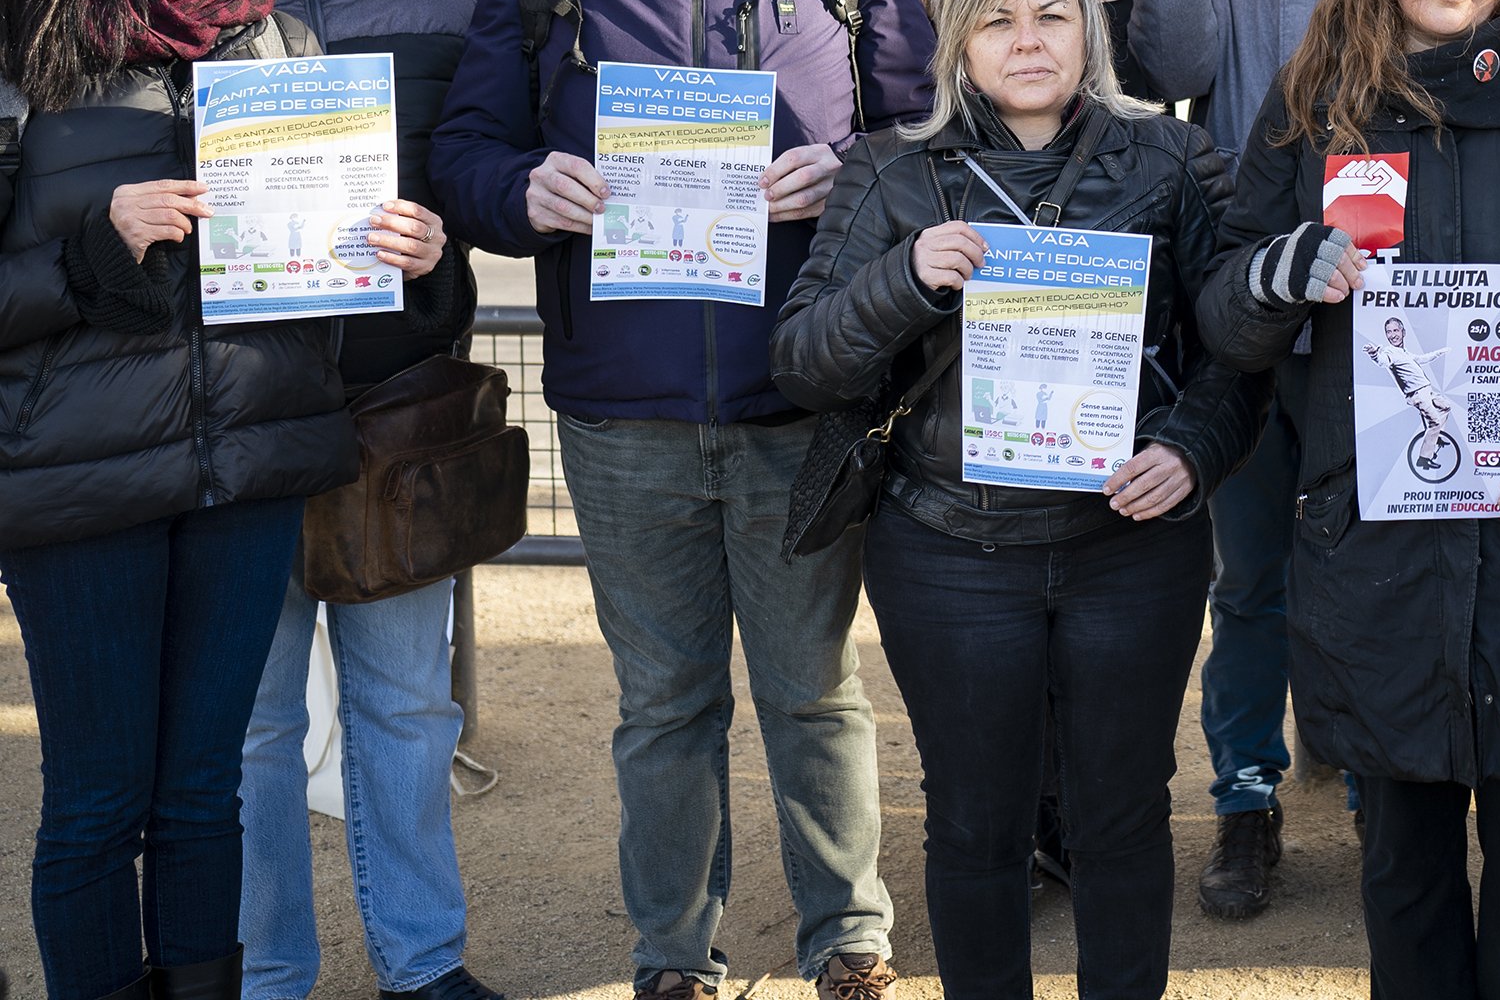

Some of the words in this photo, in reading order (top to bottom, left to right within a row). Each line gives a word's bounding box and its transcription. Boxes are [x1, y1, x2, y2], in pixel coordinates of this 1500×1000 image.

[260, 61, 327, 77] VAGA
[655, 70, 716, 85] VAGA
[208, 83, 280, 108] SANITAT
[284, 83, 287, 92] I
[292, 77, 389, 92] EDUCACIÓ
[601, 86, 674, 99] SANITAT
[677, 90, 680, 99] I
[684, 92, 770, 105] EDUCACIÓ
[216, 105, 239, 119] 25
[242, 103, 247, 113] I
[251, 100, 276, 112] 26
[281, 99, 307, 110] DE
[311, 98, 377, 108] GENER
[612, 103, 635, 113] 25
[639, 104, 642, 113] I
[646, 105, 669, 114] 26
[673, 107, 695, 117] DE
[699, 108, 759, 121] GENER
[200, 160, 212, 168] 25
[215, 158, 253, 167] GENER
[287, 156, 323, 165] GENER
[339, 155, 352, 163] 28
[354, 154, 389, 162] GENER
[612, 155, 644, 164] GENER
[674, 159, 706, 169] GENER
[735, 163, 766, 172] GENER
[1026, 231, 1089, 247] VAGA
[984, 250, 1045, 263] ANITAT
[1048, 253, 1051, 263] I
[1055, 254, 1145, 271] EDUCACIÓ
[980, 267, 1003, 277] 25
[1008, 268, 1012, 277] I
[1015, 268, 1039, 279] 26
[1044, 271, 1066, 282] DE
[1071, 273, 1132, 286] GENER
[1391, 270, 1422, 286] EN
[1424, 270, 1489, 286] LLUITA
[1362, 292, 1400, 307] PER
[1404, 292, 1429, 308] LA
[966, 321, 976, 330] 25
[978, 323, 1011, 333] GENER
[1028, 326, 1040, 334] 26
[1043, 328, 1076, 337] GENER
[1470, 325, 1487, 333] 25/1
[1091, 331, 1102, 340] 28
[1105, 332, 1137, 343] GENER
[1081, 402, 1099, 411] Sense
[1101, 404, 1122, 412] sanitat
[1096, 420, 1124, 429] educació
[1096, 429, 1103, 437] ha
[1104, 430, 1120, 438] futur
[1404, 492, 1432, 501] PROU
[1434, 491, 1484, 501] TRIPIJOCS
[1387, 504, 1433, 513] INVERTIM
[1436, 504, 1449, 512] EN
